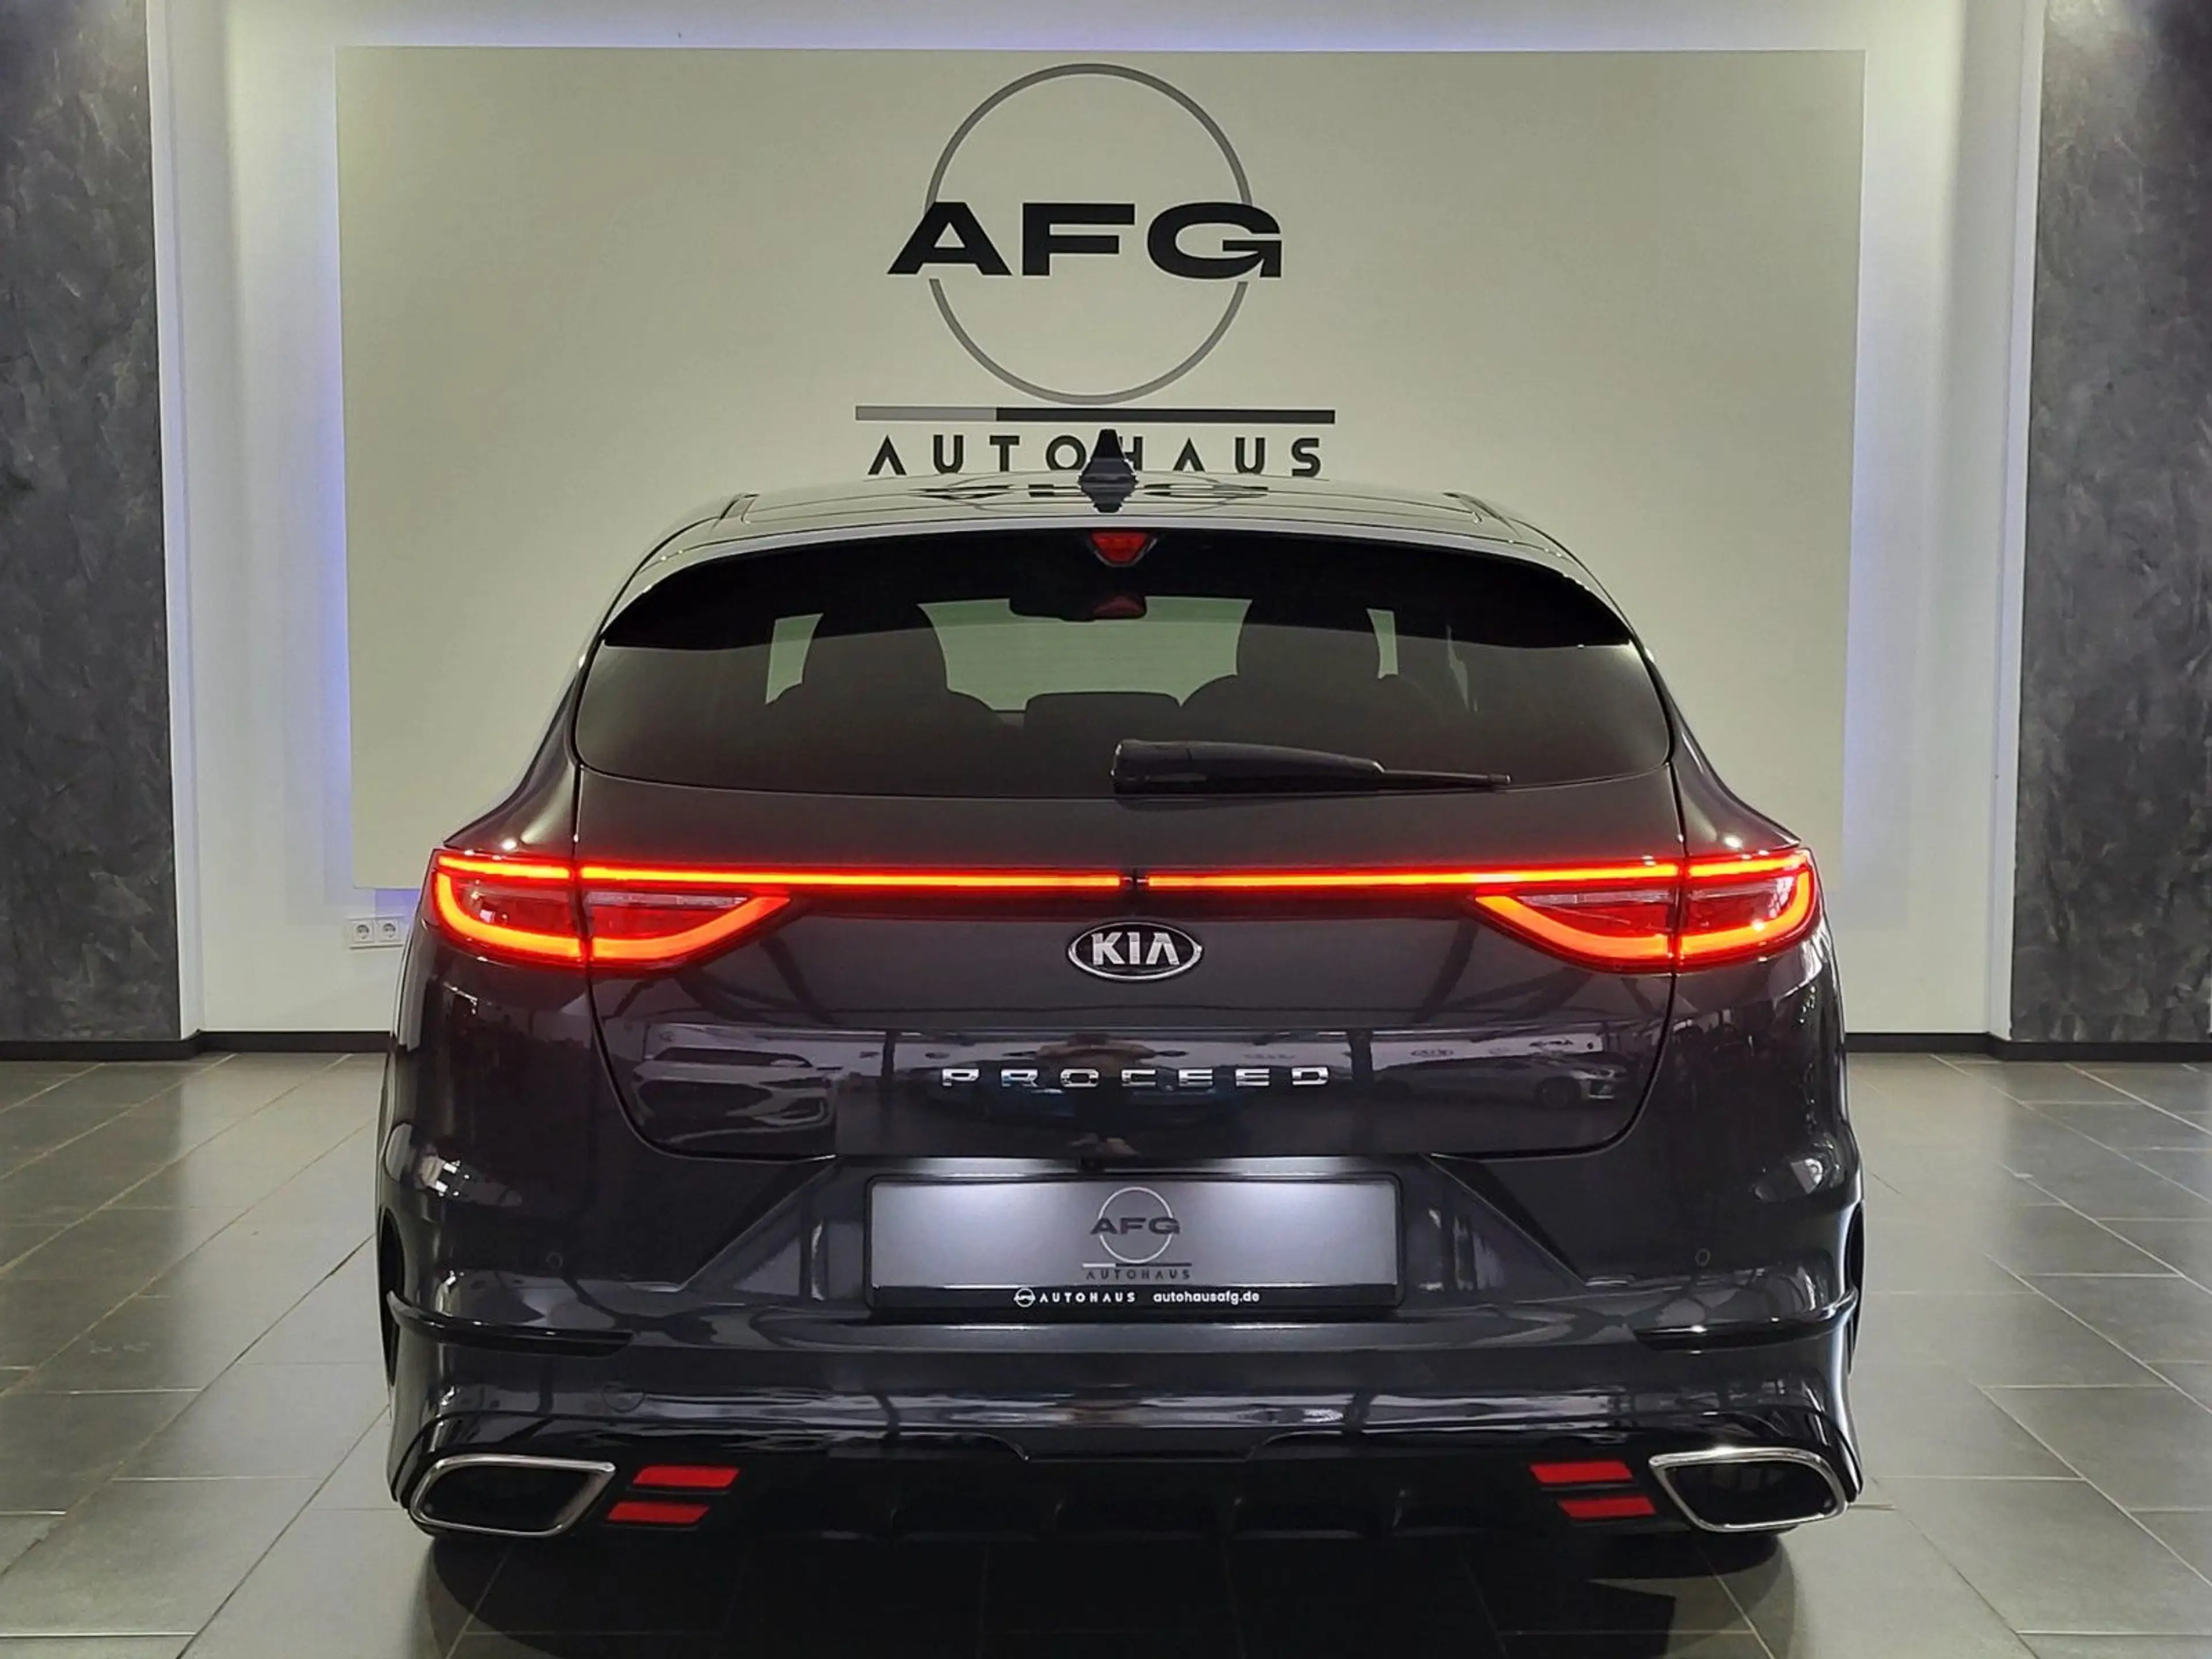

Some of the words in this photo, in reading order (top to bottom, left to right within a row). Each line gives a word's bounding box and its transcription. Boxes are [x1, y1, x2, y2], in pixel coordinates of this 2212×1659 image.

[887, 202, 1282, 279] AFG
[868, 434, 1321, 478] AUTOHAUS
[1091, 932, 1180, 966] KIA
[941, 1066, 1329, 1088] PROCEED
[1090, 1217, 1180, 1234] AFG
[1086, 1269, 1191, 1280] AUTOHAUS
[1040, 1292, 1135, 1303] AUTOHAUS
[1153, 1290, 1260, 1305] autohausafg.de
